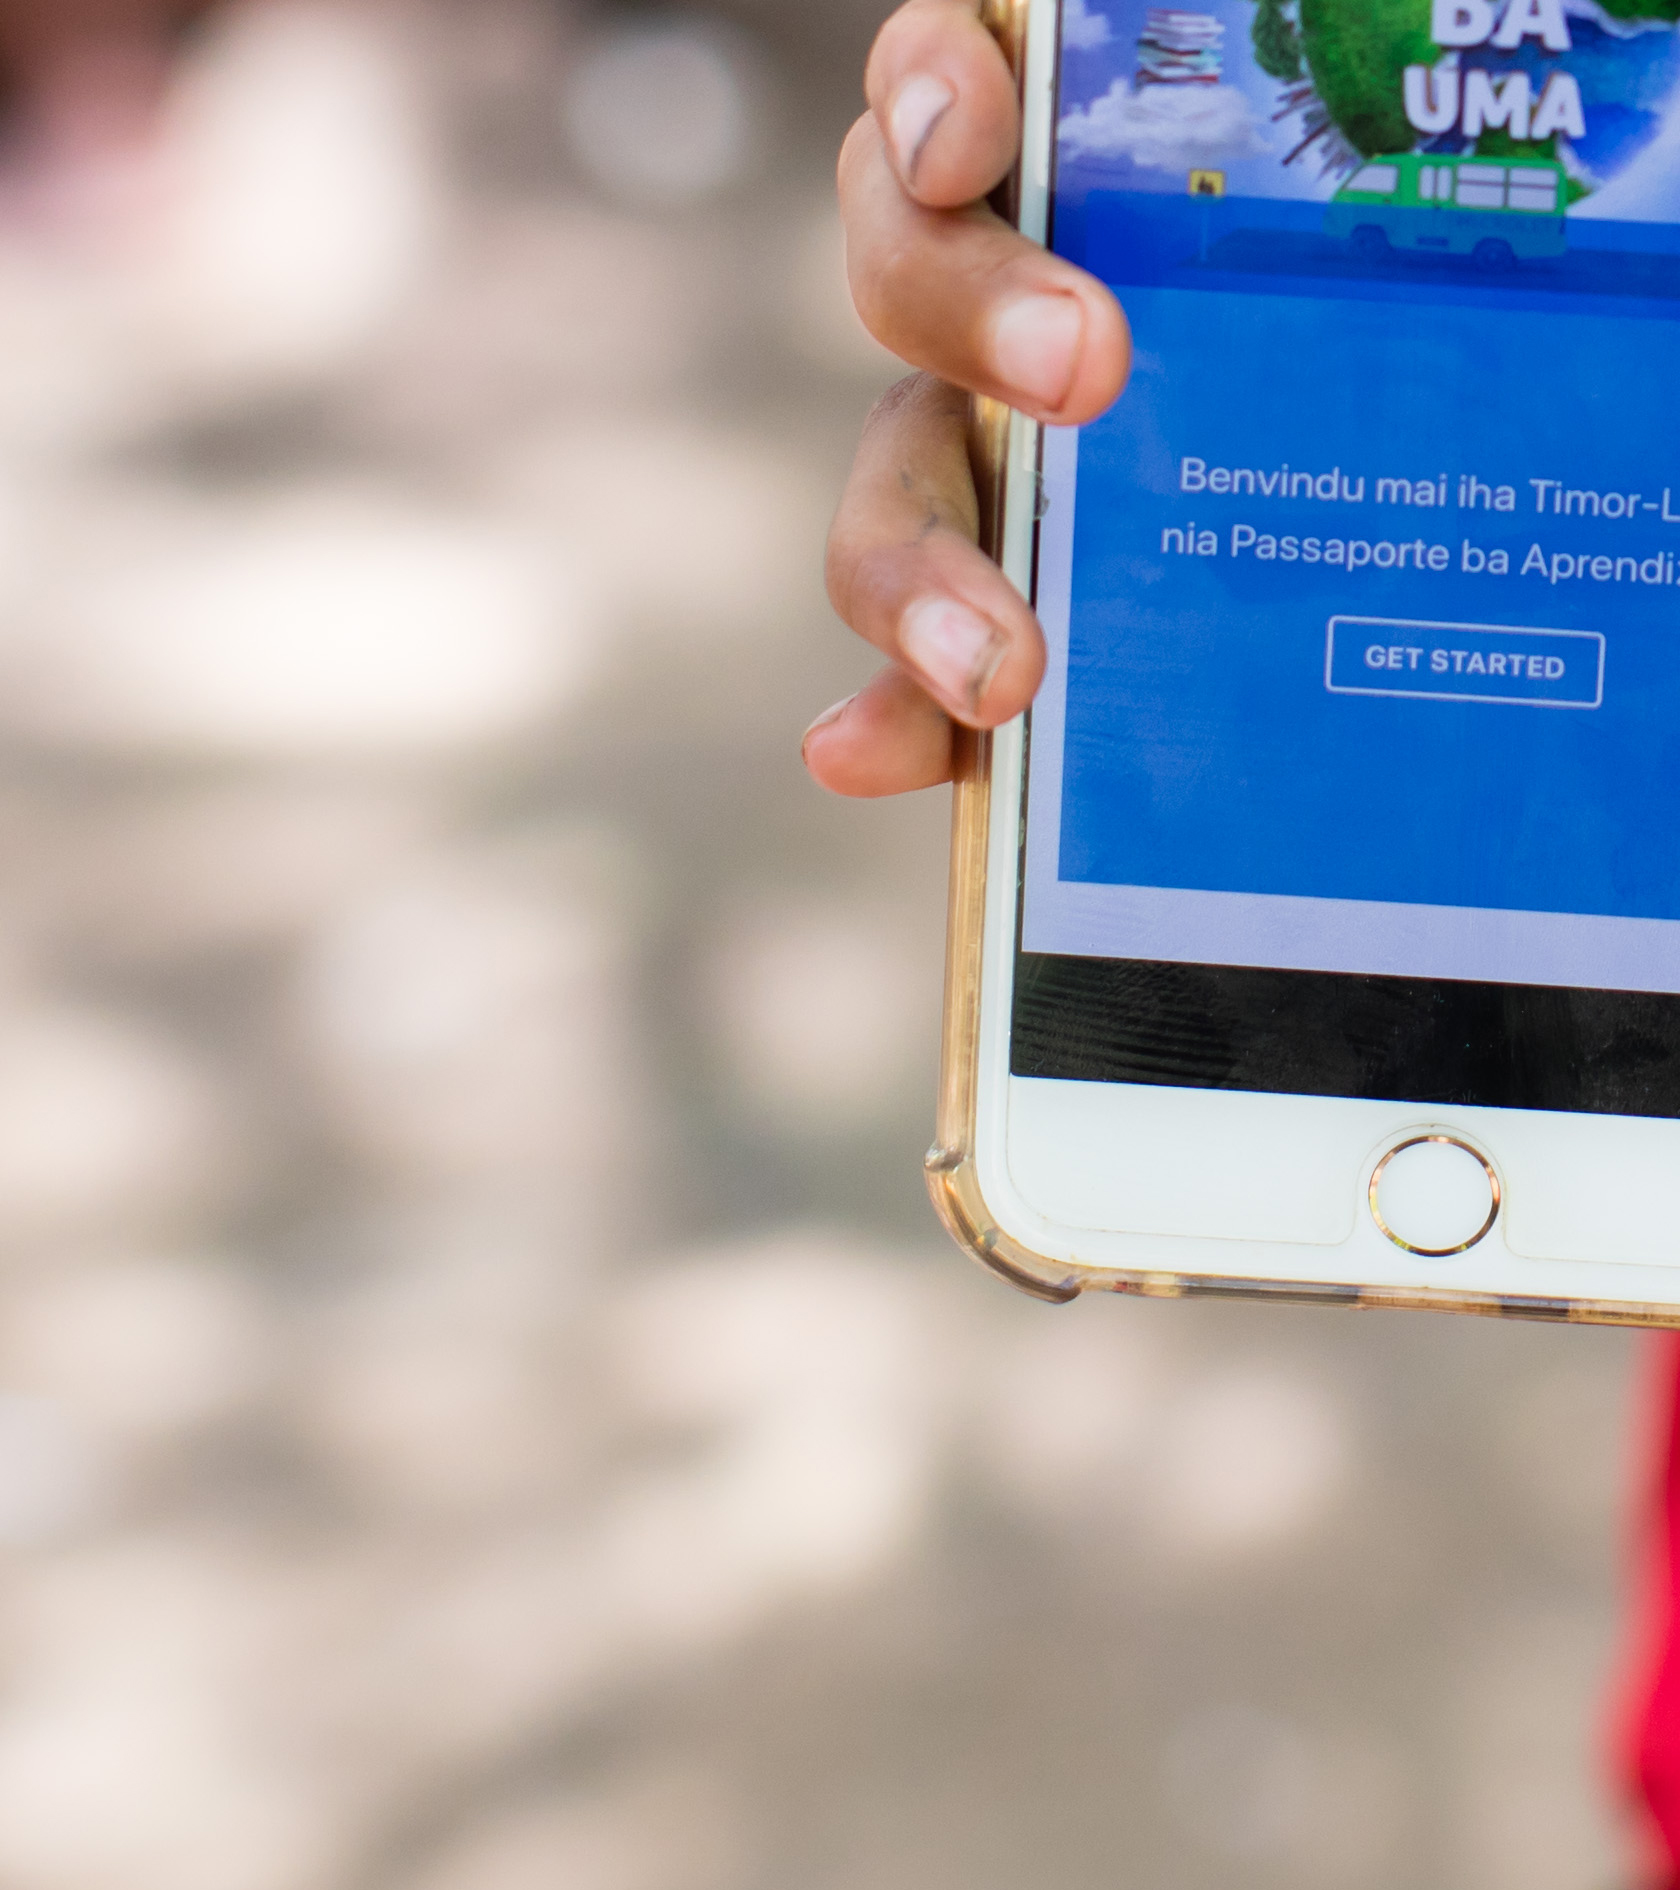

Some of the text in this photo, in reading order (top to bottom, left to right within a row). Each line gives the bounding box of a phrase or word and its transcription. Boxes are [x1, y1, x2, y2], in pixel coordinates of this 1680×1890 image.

[1403, 63, 1586, 141] UMA
[1179, 456, 1366, 502] Benvindu
[1375, 473, 1448, 508] mai
[1457, 474, 1517, 512] iha
[1161, 521, 1219, 557] nia
[1231, 523, 1450, 573] Passaporte
[1461, 538, 1510, 576] ba
[1363, 644, 1566, 680] GET STARTED
